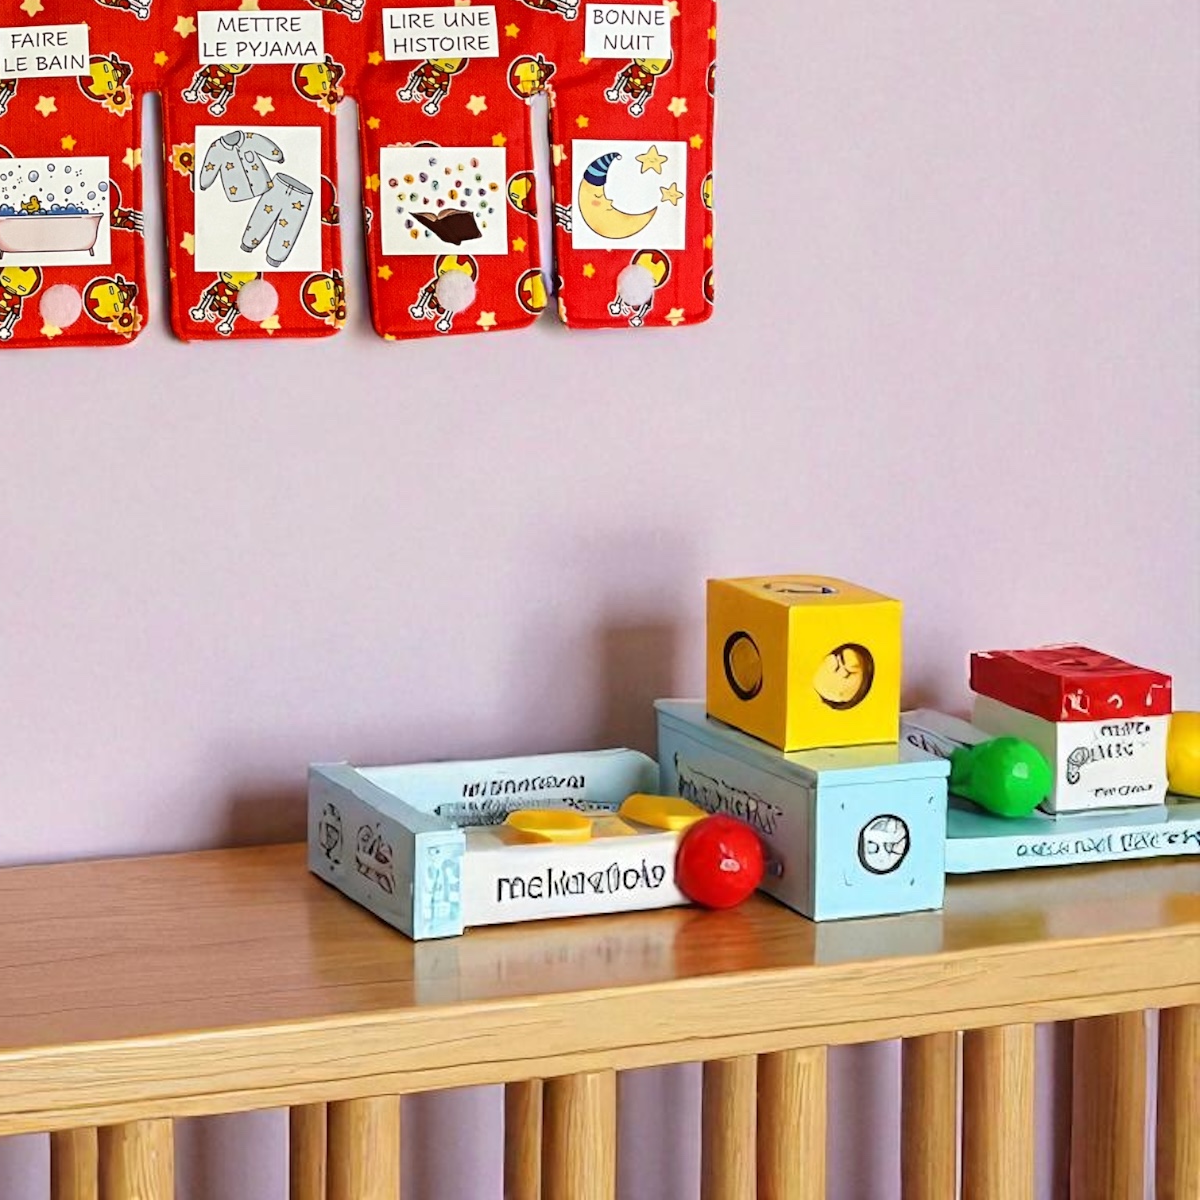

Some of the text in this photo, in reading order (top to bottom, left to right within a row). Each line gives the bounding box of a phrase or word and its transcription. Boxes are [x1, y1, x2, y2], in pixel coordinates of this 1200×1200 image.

[217, 16, 302, 33] METTRE
[390, 12, 490, 29] LIRE UNE
[593, 9, 666, 26] BONNE
[11, 31, 68, 49] FAIRE
[393, 35, 490, 54] HISTOIRE
[604, 34, 654, 51] NUIT
[203, 41, 318, 58] LE PYJAMA
[4, 54, 84, 73] LE BAIN
